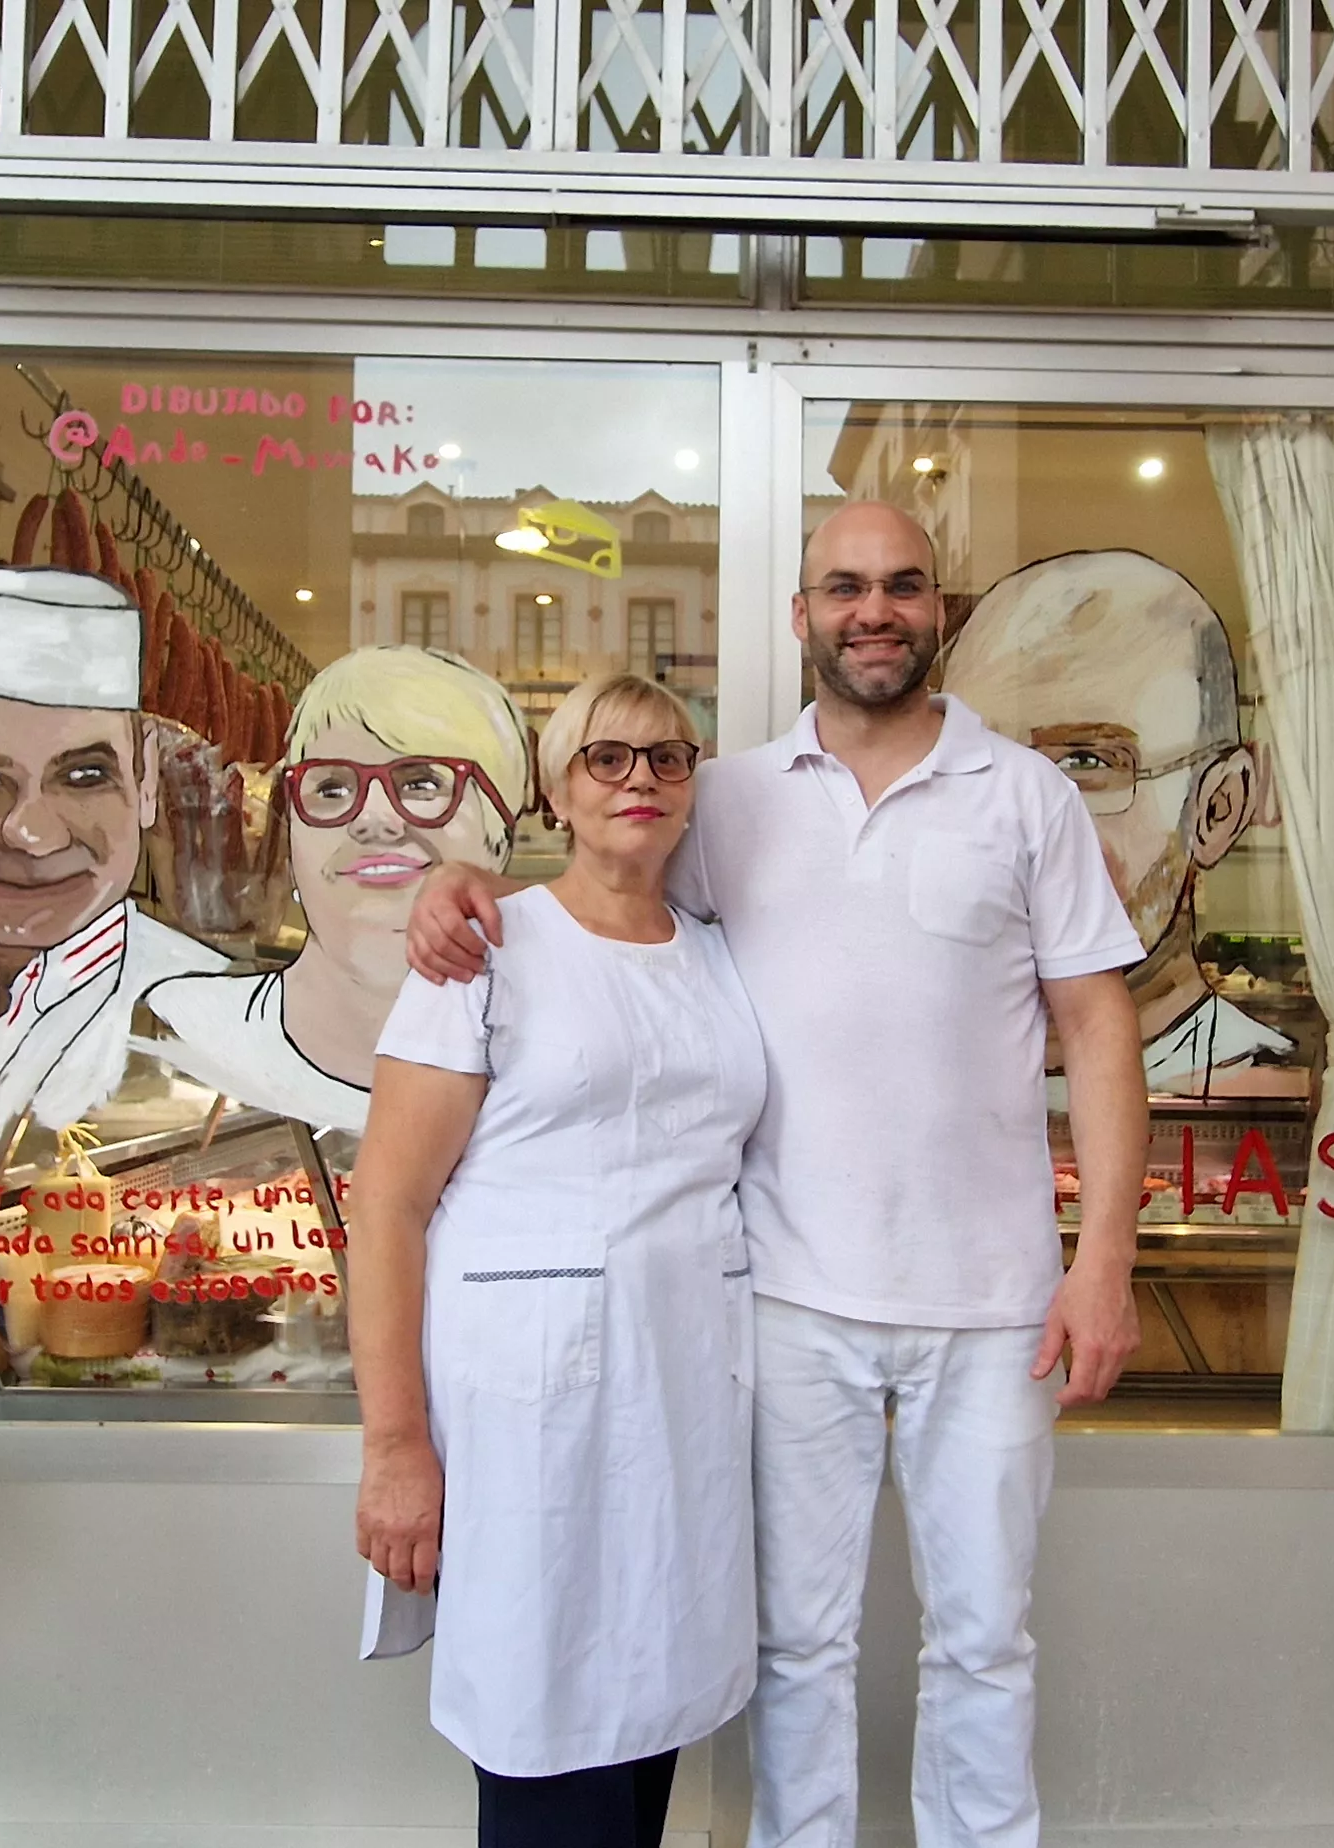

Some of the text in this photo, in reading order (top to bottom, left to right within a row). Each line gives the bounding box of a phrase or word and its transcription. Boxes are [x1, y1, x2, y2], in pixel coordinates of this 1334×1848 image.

[120, 383, 307, 418] DIBUJADO
[19, 1182, 105, 1213] cada
[121, 1180, 234, 1216] corte,
[253, 1183, 314, 1211] una
[232, 1226, 274, 1253] un
[290, 1219, 347, 1251] laz
[31, 1272, 136, 1303] todos
